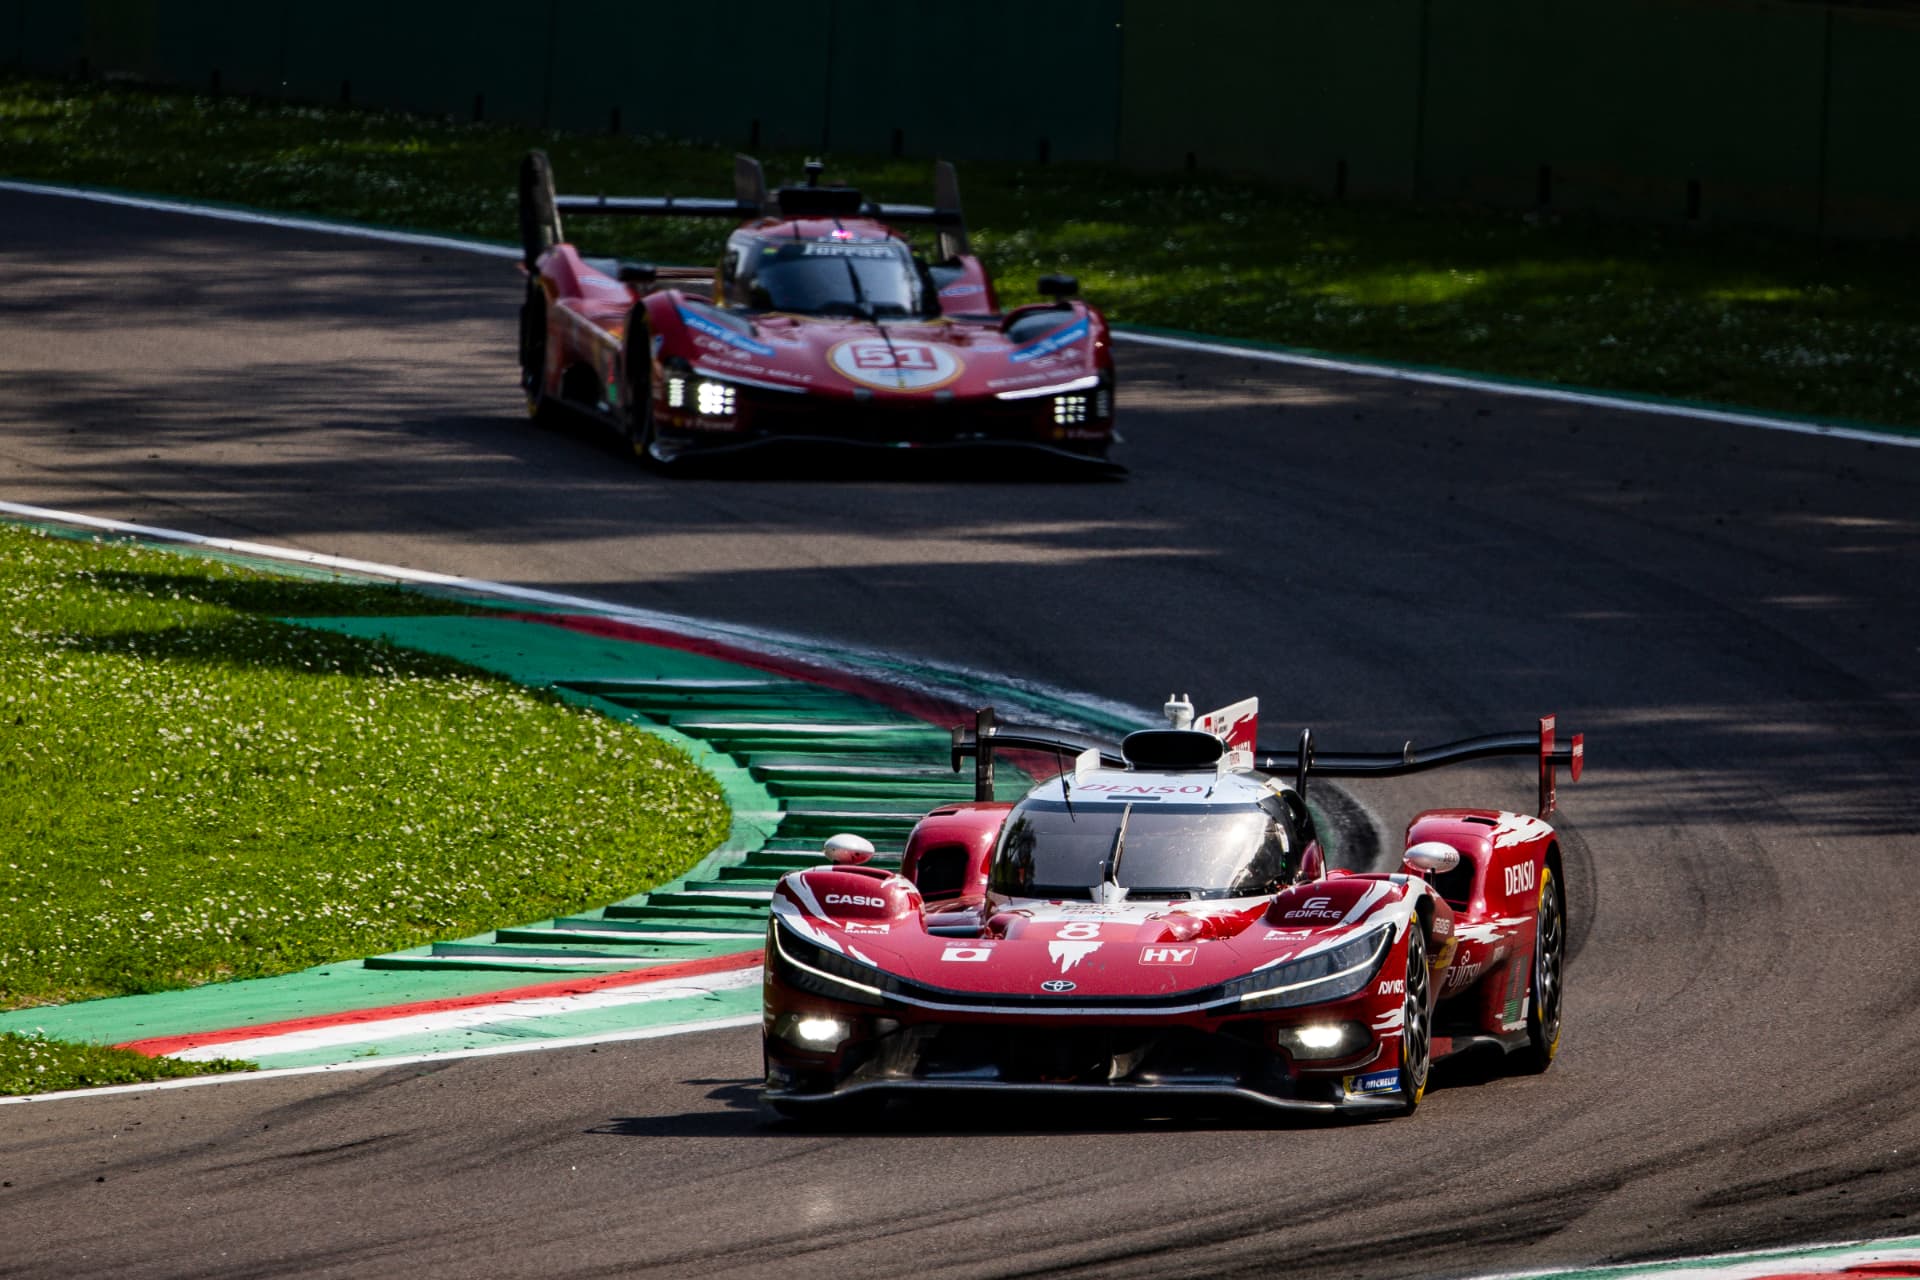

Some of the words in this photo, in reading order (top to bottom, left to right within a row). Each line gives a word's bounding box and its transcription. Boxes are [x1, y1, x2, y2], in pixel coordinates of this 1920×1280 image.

[857, 346, 933, 367] 51
[1077, 783, 1204, 795] DENSO
[1504, 859, 1535, 897] DENSO
[825, 893, 886, 908] CASIO
[1284, 909, 1343, 919] EDIFICE
[1055, 921, 1101, 941] 8
[1143, 948, 1194, 963] HY
[1364, 1075, 1399, 1089] MICHELIN
